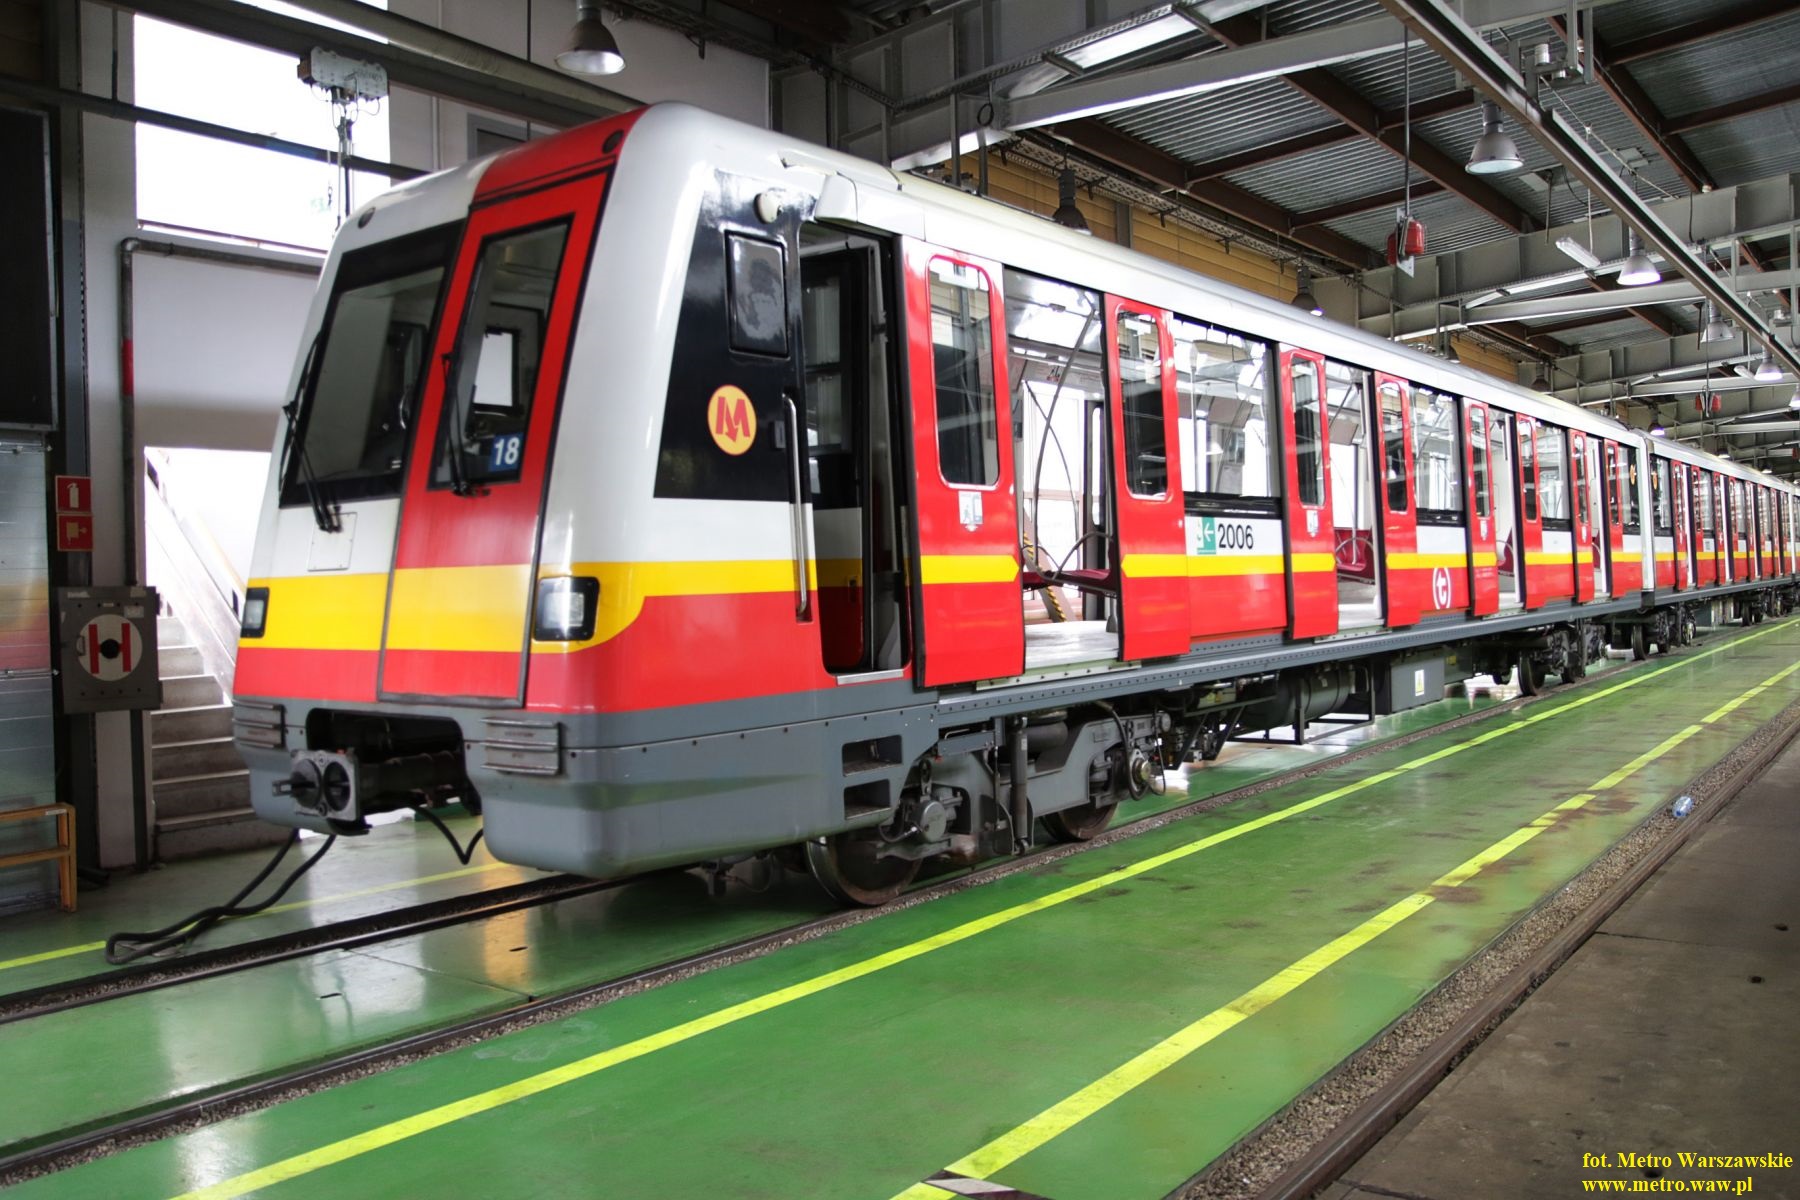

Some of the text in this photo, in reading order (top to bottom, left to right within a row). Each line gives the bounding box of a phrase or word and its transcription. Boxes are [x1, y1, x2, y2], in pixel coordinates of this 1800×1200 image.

[715, 396, 751, 442] M
[494, 436, 520, 466] 18
[1217, 523, 1254, 550] 2006
